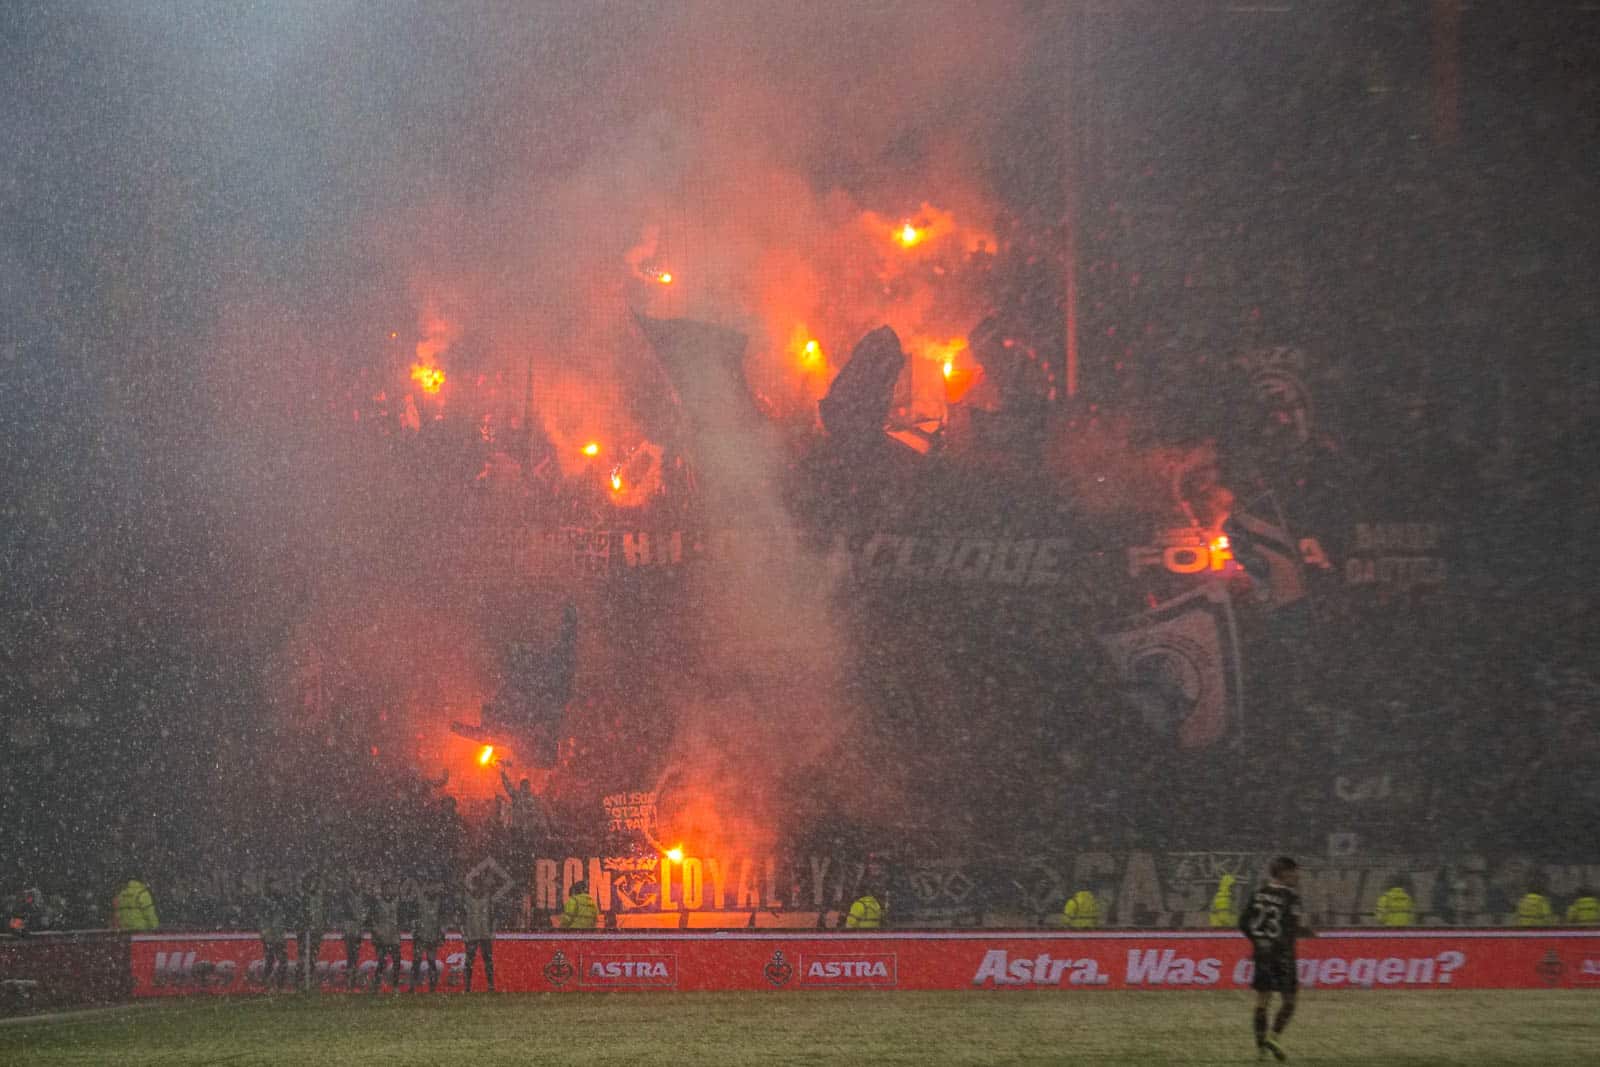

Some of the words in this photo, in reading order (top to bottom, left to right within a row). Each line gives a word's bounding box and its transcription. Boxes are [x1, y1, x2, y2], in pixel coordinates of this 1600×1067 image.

[1248, 903, 1281, 938] 23
[589, 960, 669, 979] ASTRA
[807, 960, 888, 979] ASTRA
[972, 949, 1109, 986] Astra.
[1125, 949, 1220, 986] Was
